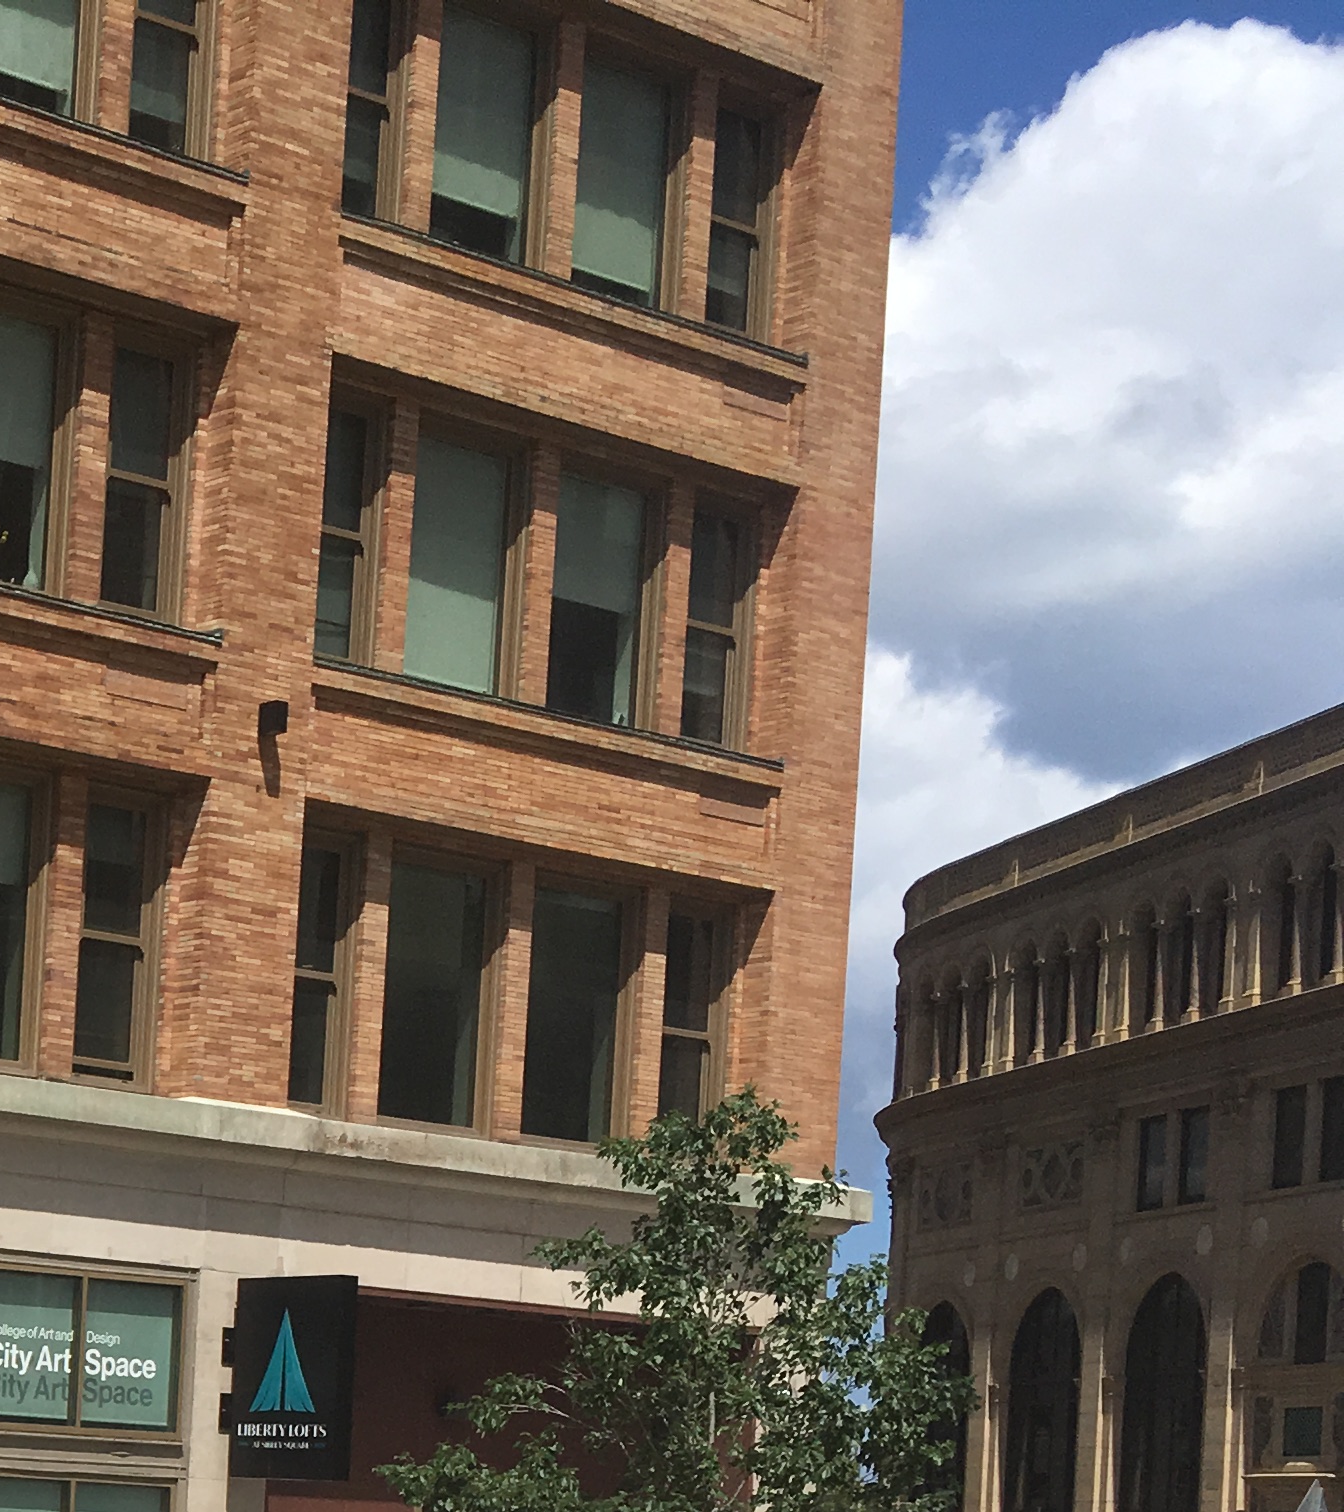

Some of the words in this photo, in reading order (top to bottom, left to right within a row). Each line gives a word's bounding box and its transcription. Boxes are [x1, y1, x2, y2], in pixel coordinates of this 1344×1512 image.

[27, 1325, 39, 1340] of
[38, 1326, 56, 1341] Art
[55, 1328, 74, 1343] and
[86, 1329, 121, 1347] Design
[35, 1345, 73, 1375] Art
[84, 1347, 157, 1382] Space
[237, 1422, 287, 1437] LIBERTY
[288, 1423, 327, 1438] LOFTS
